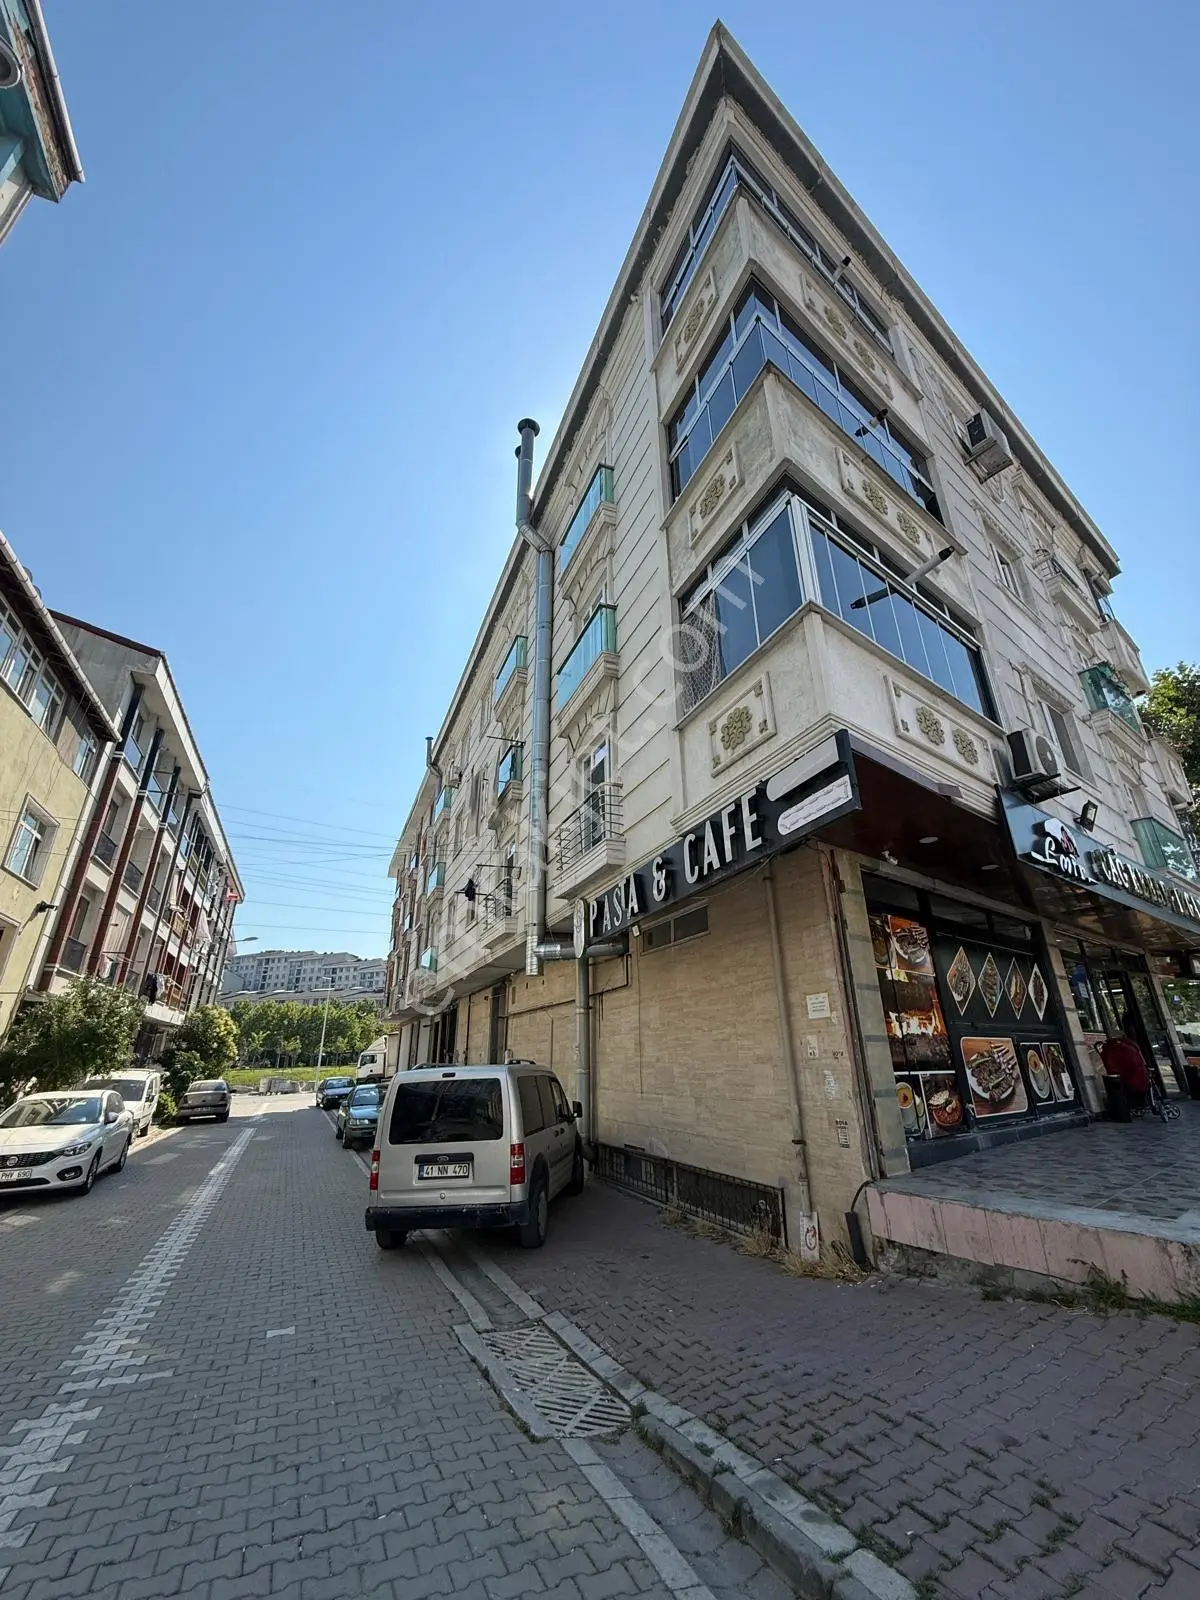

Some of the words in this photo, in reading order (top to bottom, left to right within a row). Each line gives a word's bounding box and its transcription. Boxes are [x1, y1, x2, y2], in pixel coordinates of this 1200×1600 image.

[589, 872, 639, 938] PASTA
[652, 856, 667, 902] &
[683, 787, 763, 884] CAFE
[425, 1166, 433, 1176] 41
[437, 1165, 449, 1175] NN
[452, 1164, 468, 1175] 470
